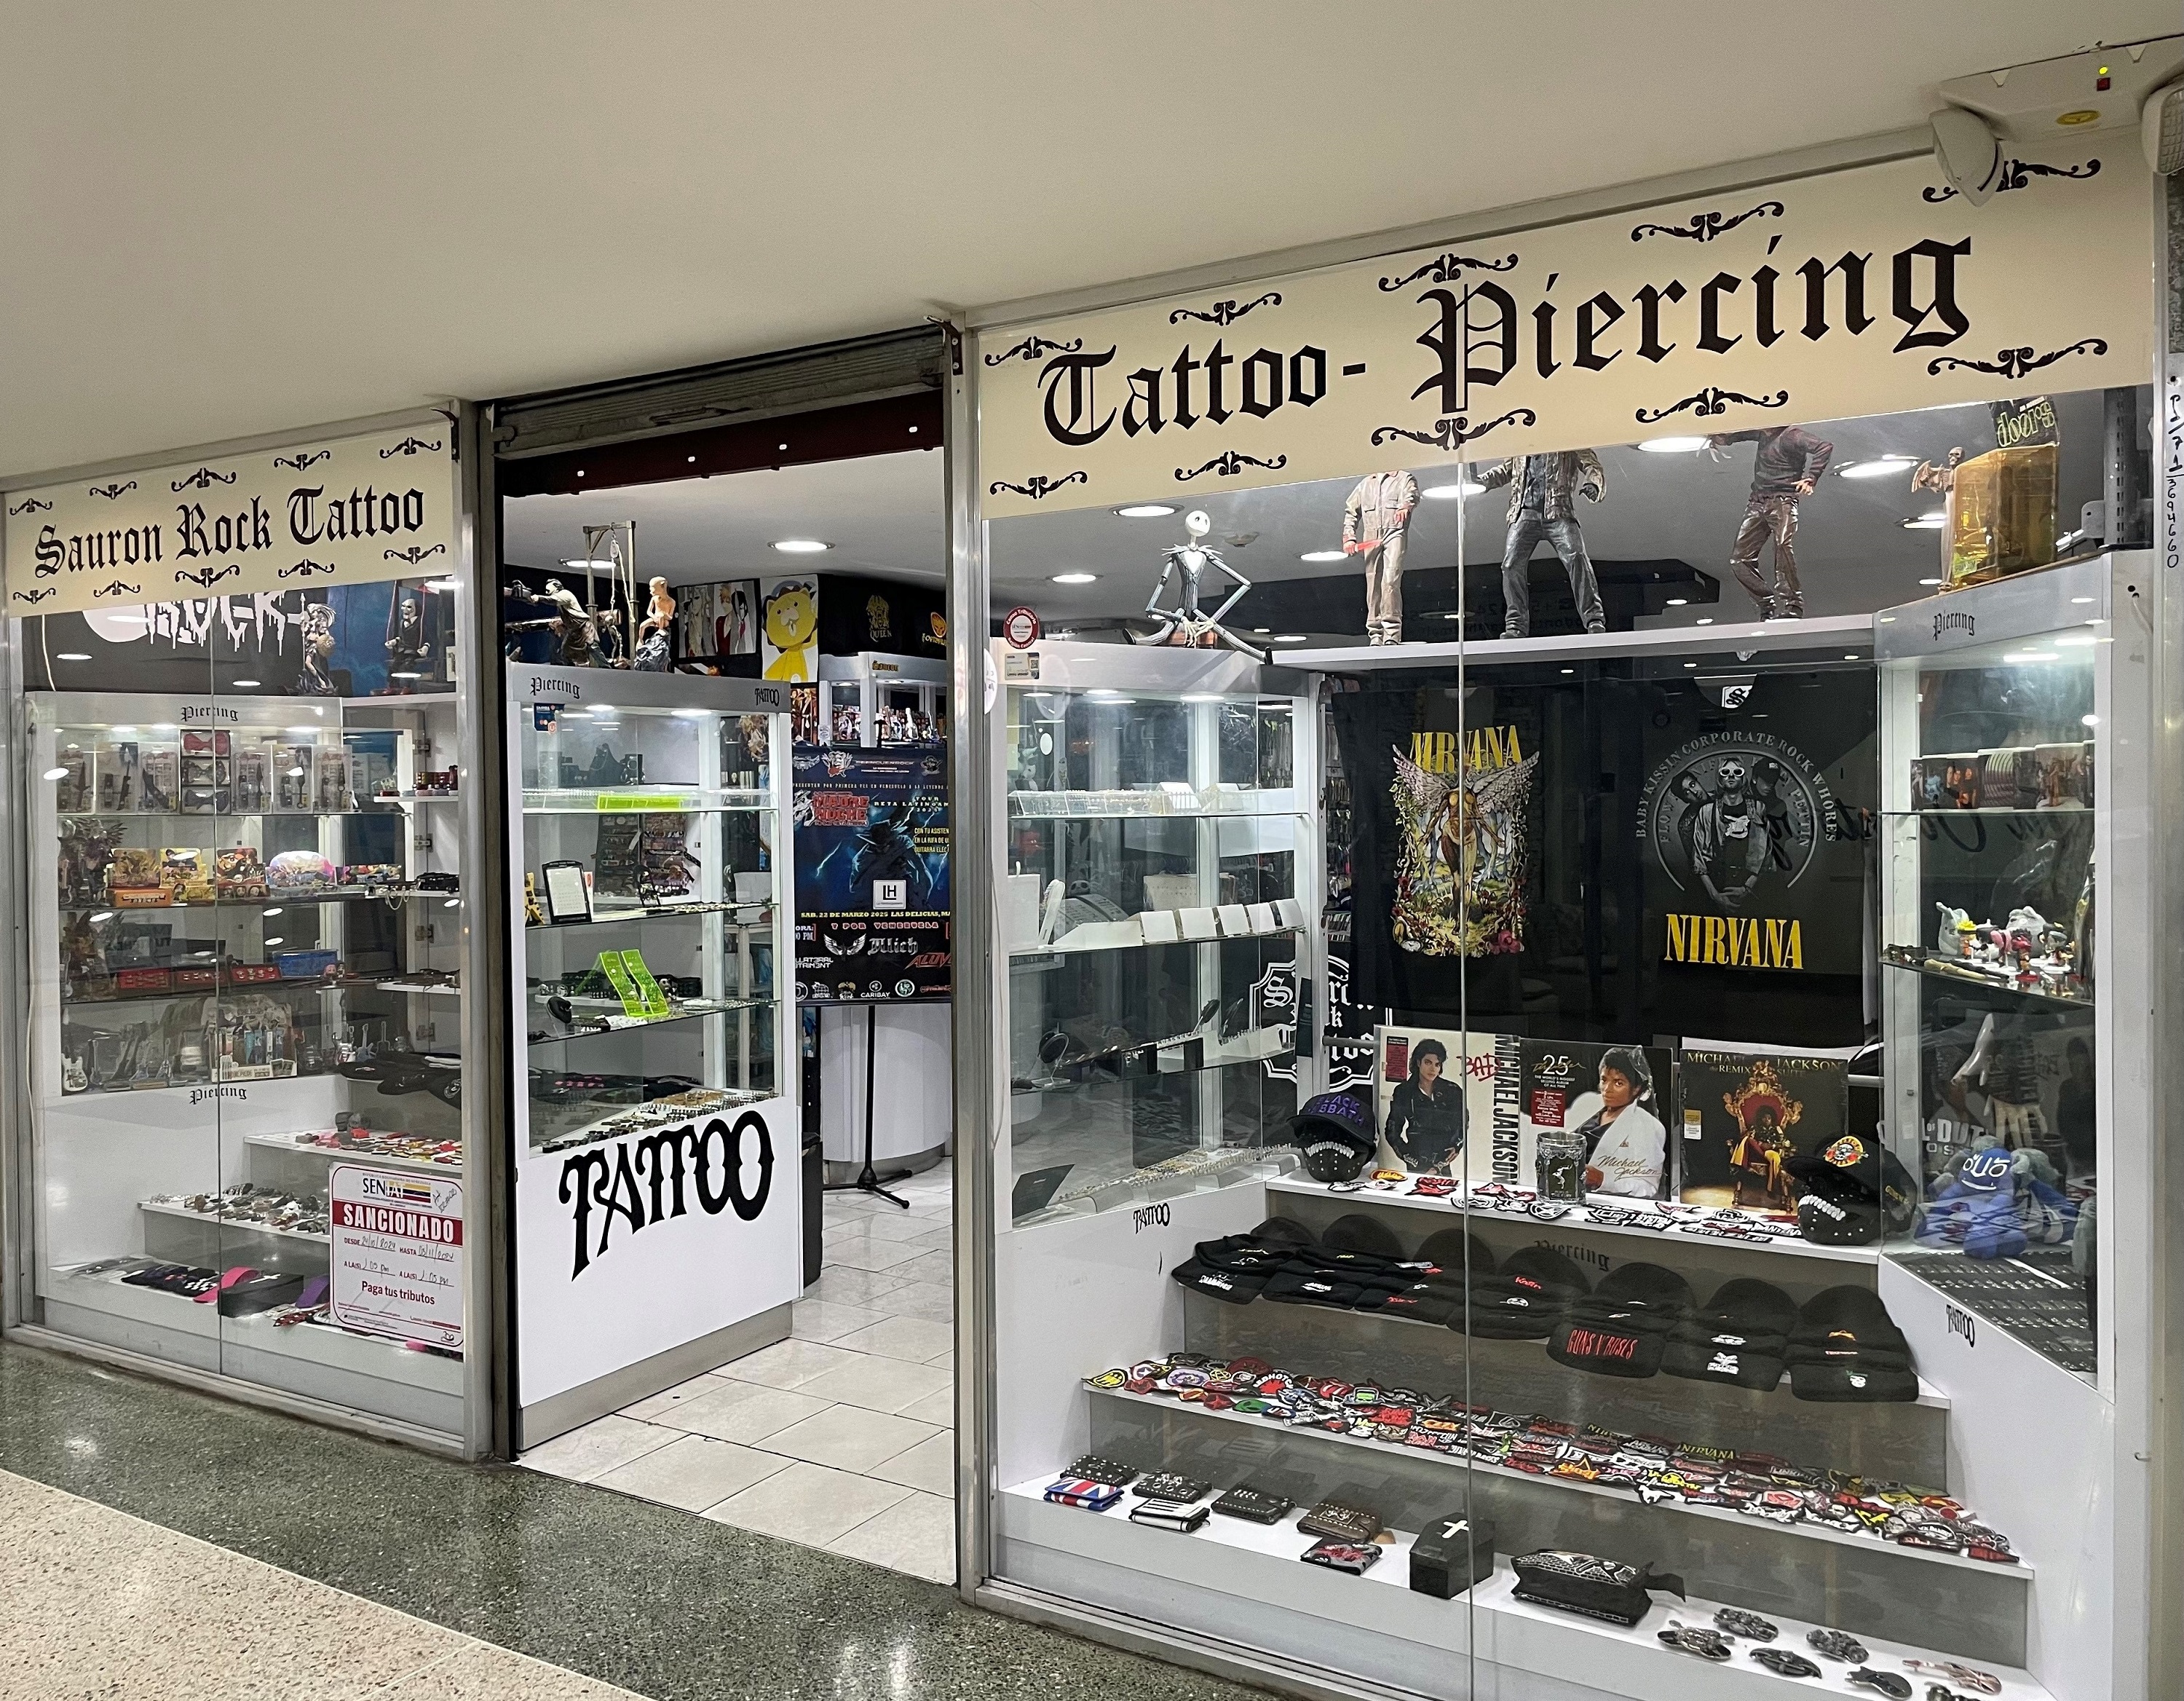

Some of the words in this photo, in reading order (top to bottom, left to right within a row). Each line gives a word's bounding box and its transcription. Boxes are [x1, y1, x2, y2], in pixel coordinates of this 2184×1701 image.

[1410, 235, 1971, 414] Piercing
[1998, 402, 2054, 447] doors
[34, 523, 163, 579] Sauron
[175, 495, 274, 560] Rock
[287, 484, 424, 545] Tattoo
[870, 628, 892, 642] QUEEN
[1932, 610, 1975, 641] Piercing
[530, 676, 580, 700] Piercing
[755, 687, 780, 707] TATTOO
[1636, 797, 1649, 837] BABY
[1643, 751, 1682, 794] KISSIN
[1682, 730, 1775, 755] CORPORATE
[1778, 739, 1814, 773] ROCK
[1812, 772, 1837, 842] WHORES
[1663, 913, 1804, 971] NIRVANA
[1456, 1052, 1501, 1082] BAD
[1495, 1035, 1520, 1106] MICHAEL
[1543, 1054, 1569, 1076] 25
[1719, 1065, 1752, 1074] REMIX
[1776, 1057, 1843, 1072] JACKSON
[1492, 1108, 1519, 1185] JACKSON
[1937, 1118, 1988, 1148] DUT
[1598, 1155, 1649, 1167] Michael
[1614, 1167, 1661, 1182] Jackson
[363, 1177, 405, 1199] SENIAT
[558, 1110, 775, 1282] TATTOO
[343, 1204, 454, 1243] SANCIONADO
[1133, 1203, 1170, 1234] TATTOO
[344, 1237, 360, 1245] DESDE
[400, 1247, 416, 1255] HASTA
[362, 1281, 383, 1296] Paga
[384, 1286, 398, 1298] tus
[400, 1288, 435, 1305] tributos
[1946, 1304, 1975, 1349] TATTOO
[1567, 1329, 1596, 1355] GUNS
[1681, 1443, 1735, 1460] NIRVANA
